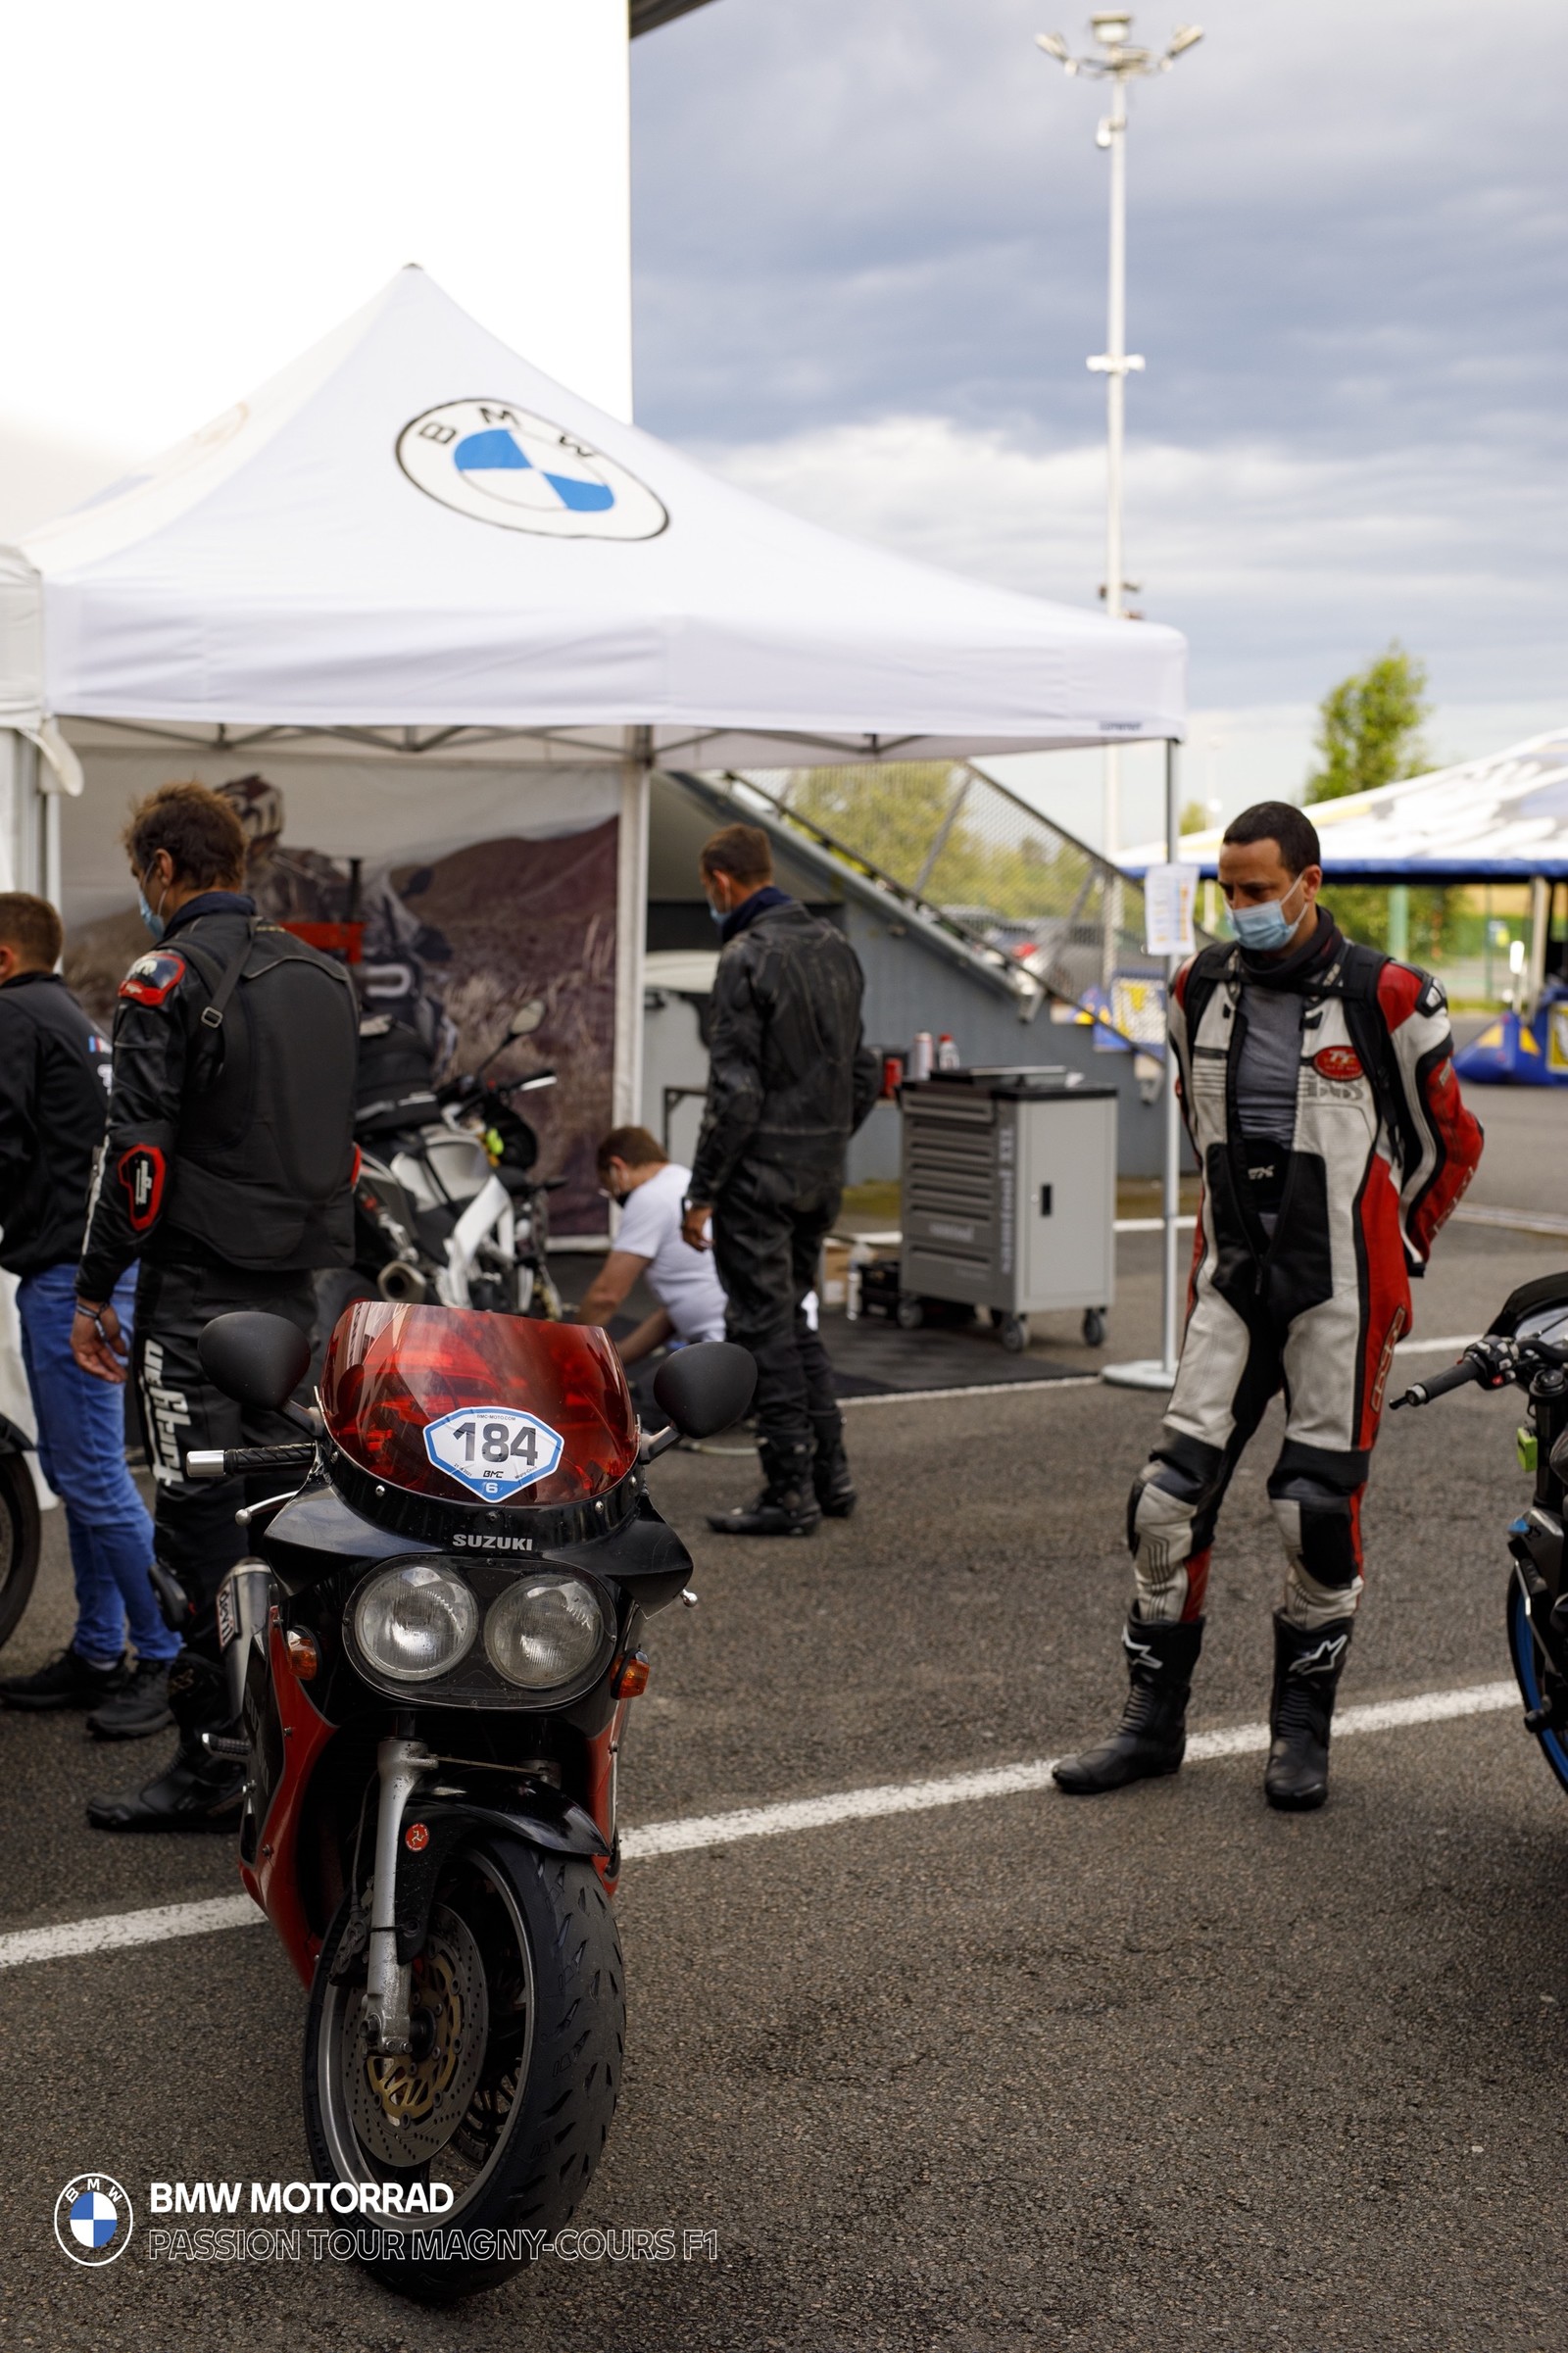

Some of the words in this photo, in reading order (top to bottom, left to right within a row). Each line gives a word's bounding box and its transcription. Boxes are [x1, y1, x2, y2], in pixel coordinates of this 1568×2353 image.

[418, 406, 596, 458] BMW
[453, 1422, 539, 1467] 184
[482, 1470, 505, 1479] BMC
[485, 1482, 499, 1494] 6
[452, 1534, 533, 1551] SUZUKI
